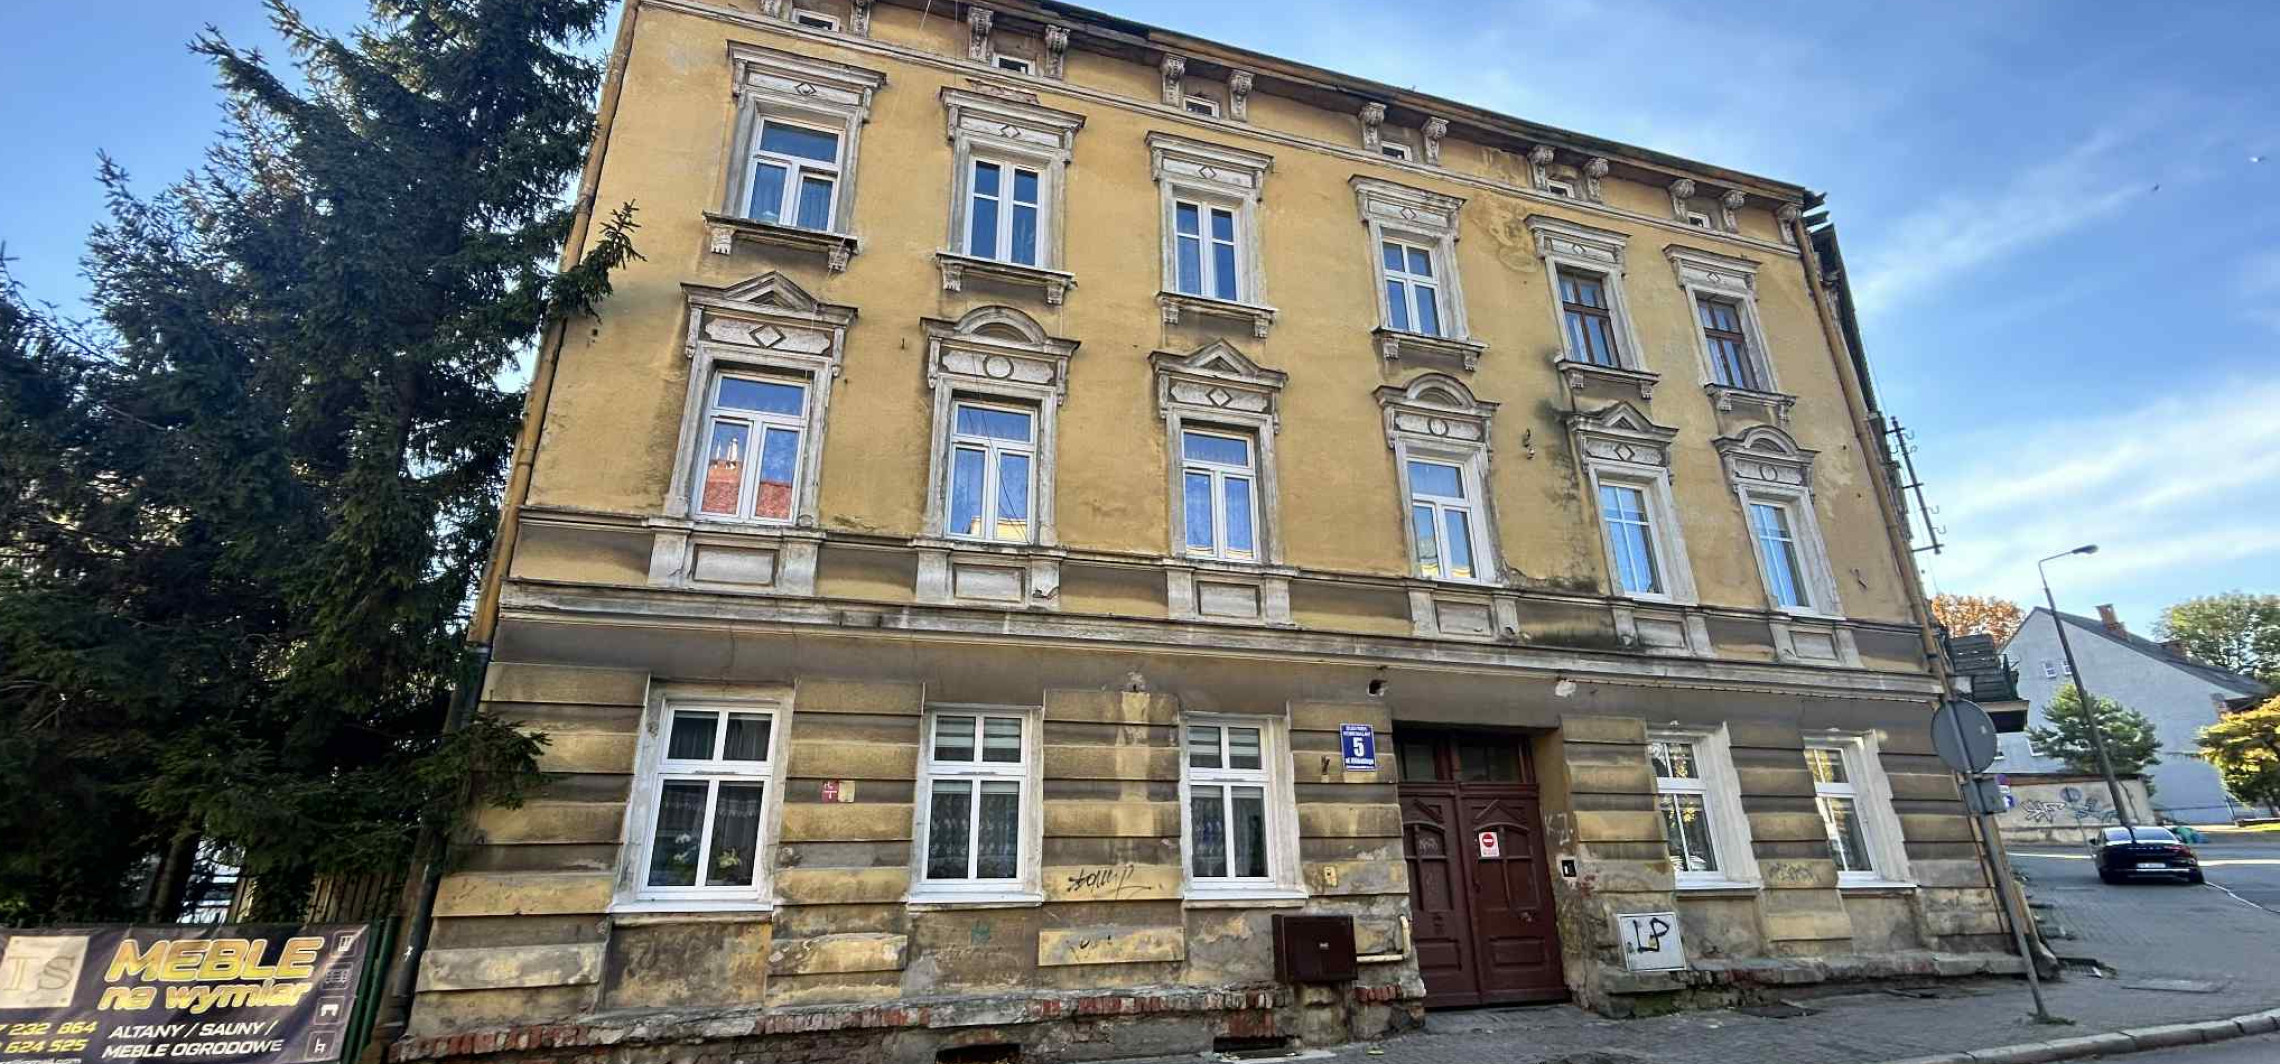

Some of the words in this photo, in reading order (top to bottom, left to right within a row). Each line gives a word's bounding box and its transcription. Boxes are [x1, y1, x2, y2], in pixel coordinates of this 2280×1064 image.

[1352, 736, 1365, 757] 5
[105, 936, 324, 983] MEBLE
[97, 984, 157, 1011] na
[165, 980, 313, 1014] wymiar
[8, 1022, 52, 1036] 232
[108, 1023, 187, 1039] ALTANY
[198, 1020, 266, 1036] SAUNY
[3, 1040, 47, 1054] 624
[101, 1043, 171, 1059] MEBLE
[170, 1038, 285, 1057] OGRODOWE
